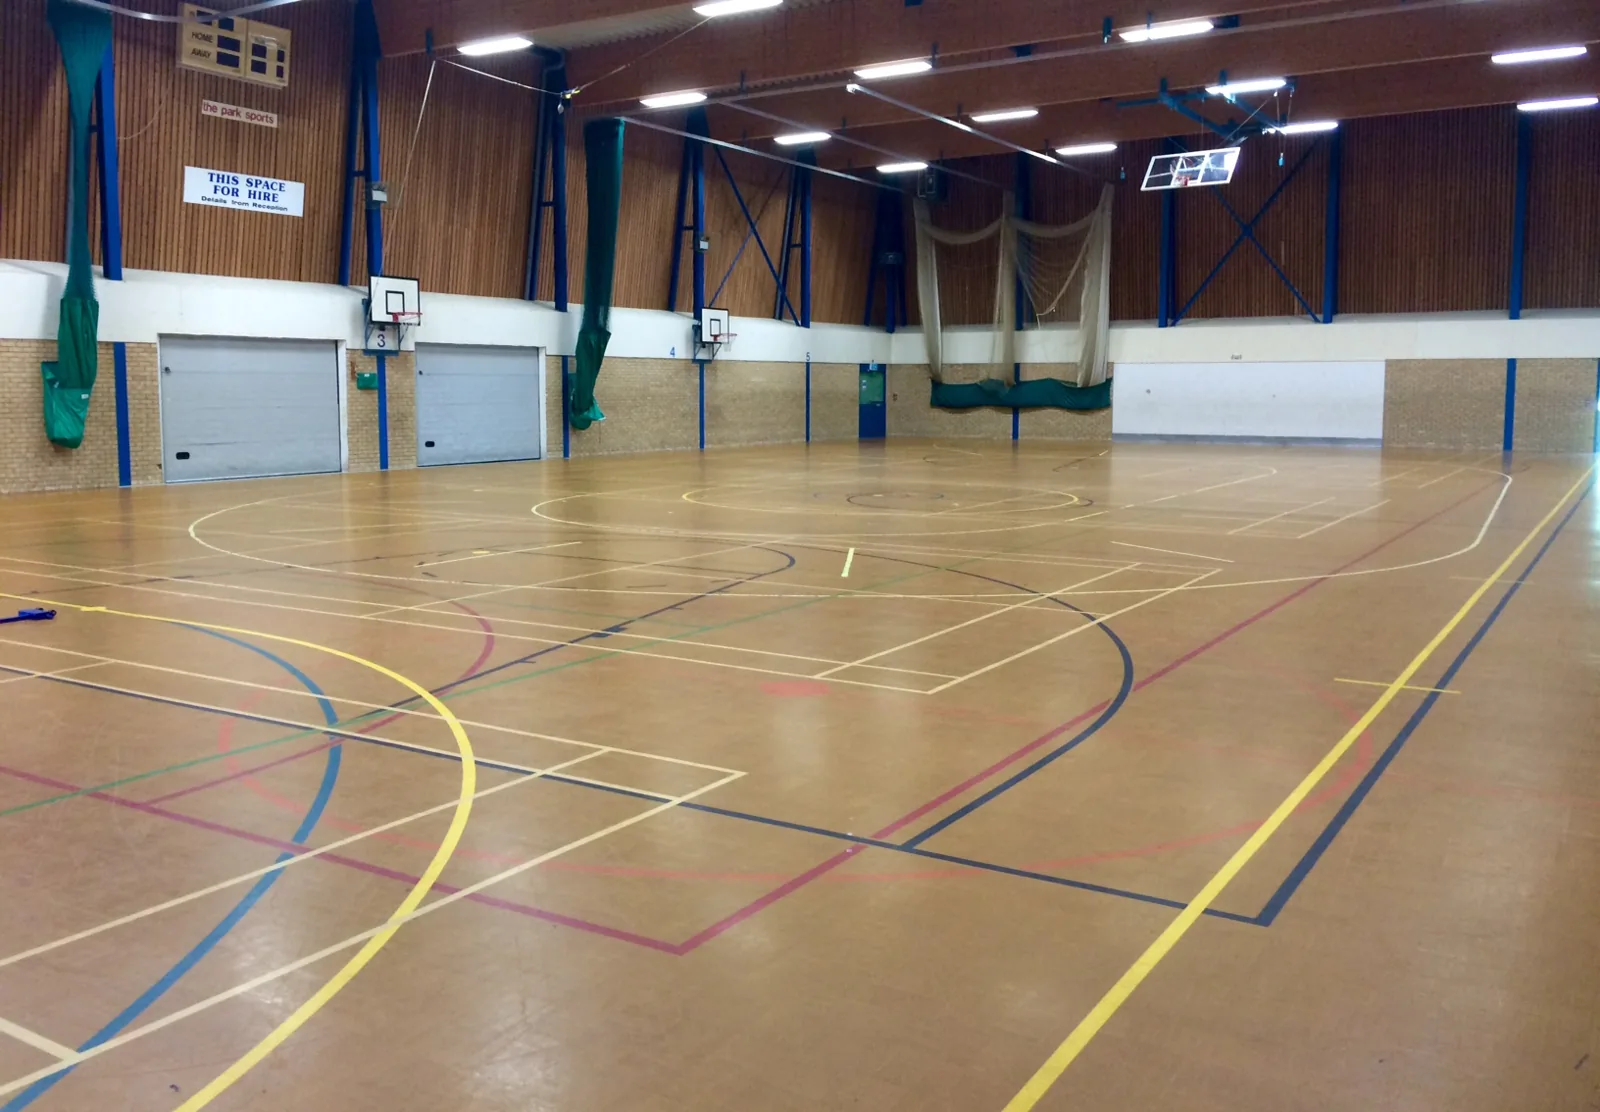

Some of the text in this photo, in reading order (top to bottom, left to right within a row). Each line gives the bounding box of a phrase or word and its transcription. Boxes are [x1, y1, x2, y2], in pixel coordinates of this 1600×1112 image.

[192, 32, 213, 43] HOME
[190, 48, 211, 59] AWAY
[203, 102, 274, 124] the park sports
[208, 172, 286, 192] THIS SPACE
[213, 185, 279, 203] FOR HIRE
[201, 195, 288, 212] Details from Reception
[377, 333, 386, 348] 3
